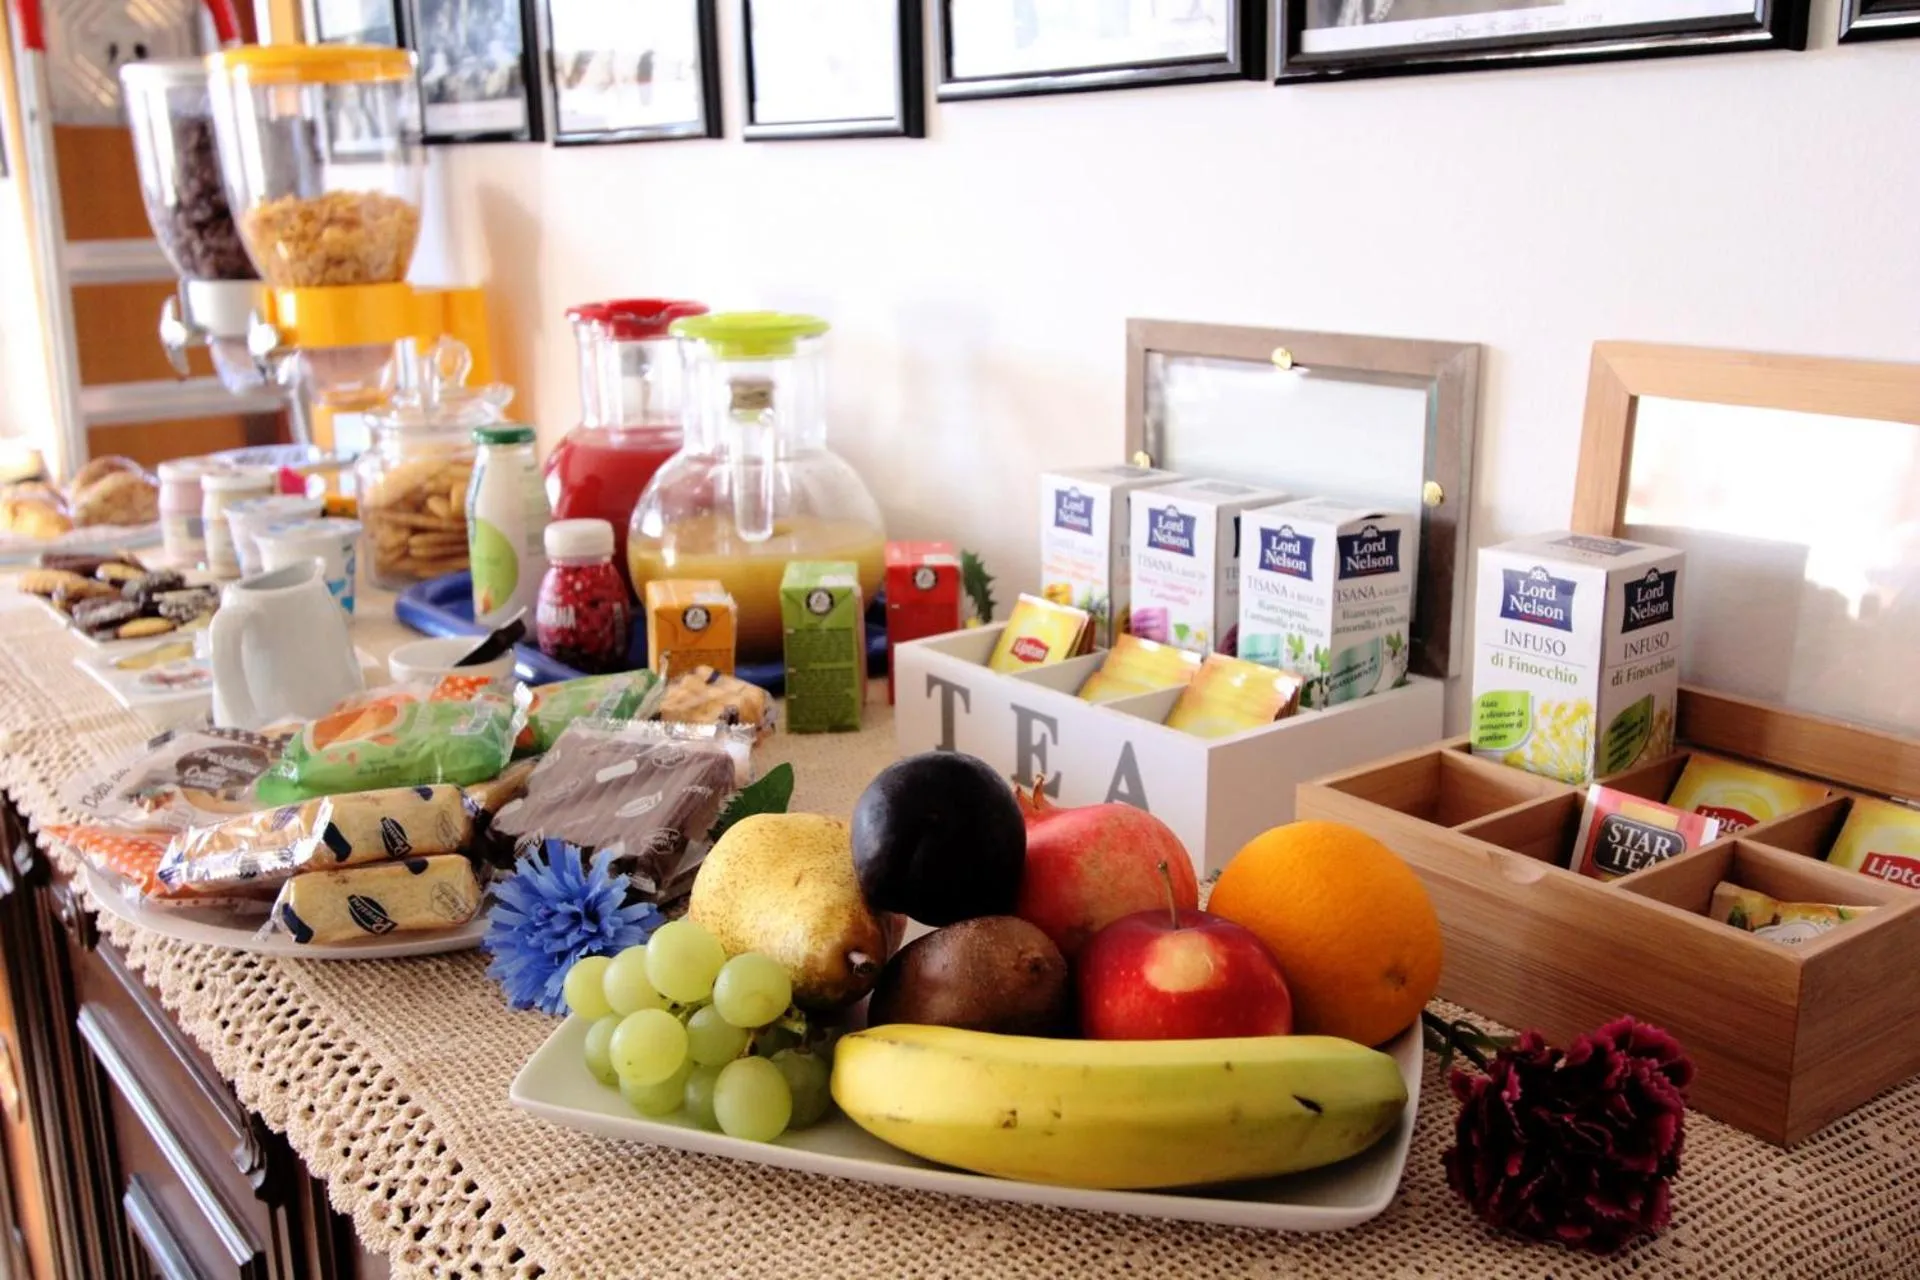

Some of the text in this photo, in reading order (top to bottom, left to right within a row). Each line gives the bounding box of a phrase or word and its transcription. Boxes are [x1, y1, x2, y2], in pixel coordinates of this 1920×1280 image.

[1062, 497, 1085, 514] Lord
[1058, 509, 1090, 527] Nelson
[1158, 515, 1185, 533] Lord
[1152, 528, 1190, 549] Nelson
[1271, 536, 1300, 553] Lord
[1353, 537, 1386, 555] Lord
[1265, 550, 1307, 572] Nelson
[1346, 555, 1394, 571] Nelson
[1248, 576, 1288, 597] TISANA
[1518, 580, 1557, 601] Lord
[1636, 581, 1664, 602] Lord
[1509, 595, 1564, 621] Nelson
[1629, 600, 1669, 622] Nelson
[1504, 628, 1566, 657] INFUSO
[1624, 630, 1670, 660] INFUSO
[1491, 652, 1578, 685] di Finocchio
[1612, 656, 1675, 686] di Finocchio
[926, 673, 1150, 812] TEA
[1607, 822, 1672, 860] STAR
[1611, 844, 1657, 872] TEA
[1867, 857, 1920, 887] Lipto
